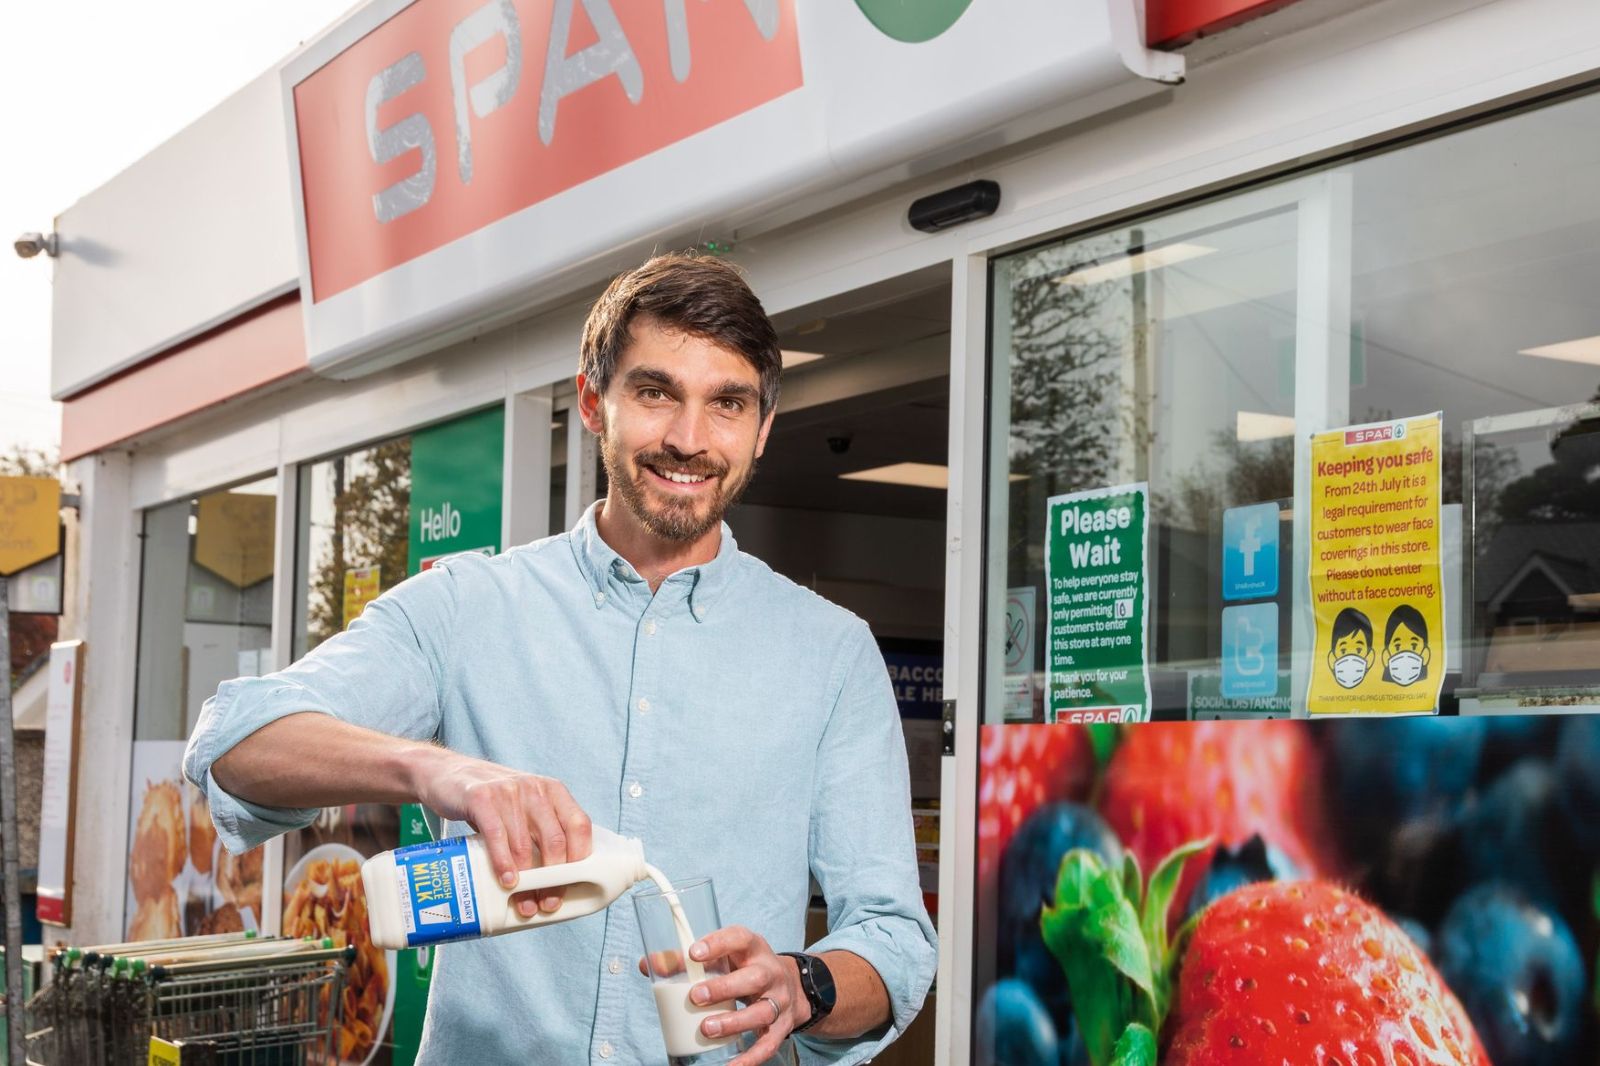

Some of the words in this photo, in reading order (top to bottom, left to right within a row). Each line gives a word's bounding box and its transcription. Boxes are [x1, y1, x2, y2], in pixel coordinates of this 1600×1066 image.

[1355, 428, 1392, 442] SPAR
[1318, 455, 1374, 478] Keeping
[1376, 454, 1403, 474] you
[1405, 446, 1433, 466] safe
[1325, 485, 1351, 498] From
[1353, 480, 1377, 495] 24th
[1380, 477, 1400, 493] July
[1403, 476, 1411, 488] it
[1412, 474, 1419, 487] is
[1420, 476, 1426, 486] a
[1323, 504, 1346, 521] legal
[1347, 498, 1412, 518] requirement
[1414, 495, 1428, 508] for
[421, 502, 461, 543] Hello
[1061, 506, 1130, 536] Please
[1318, 525, 1371, 540] customers
[1373, 523, 1384, 535] to
[1386, 522, 1411, 533] wear
[1413, 517, 1433, 530] face
[1069, 535, 1121, 568] Wait
[1321, 545, 1368, 561] coverings
[1370, 544, 1379, 556] in
[1381, 542, 1400, 555] this
[1401, 540, 1430, 553] store.
[1053, 578, 1062, 589] To
[1063, 576, 1080, 590] help
[1081, 574, 1119, 587] everyone
[1120, 570, 1138, 583] stay
[1327, 569, 1358, 581] Please
[1360, 566, 1374, 578] do
[1375, 565, 1393, 576] not
[1394, 563, 1422, 574] enter
[1054, 592, 1071, 605] safe,
[1072, 592, 1083, 602] we
[1085, 591, 1097, 601] are
[1099, 584, 1138, 599] currently
[1318, 589, 1356, 603] without
[1357, 590, 1364, 599] a
[1365, 586, 1388, 599] face
[1389, 581, 1435, 599] covering.
[1054, 607, 1070, 621] only
[1070, 603, 1112, 621] permitting
[1054, 622, 1095, 635] customers
[1095, 621, 1104, 631] to
[1105, 619, 1127, 630] enter
[1054, 638, 1068, 650] this
[1070, 638, 1090, 649] store
[1091, 637, 1100, 648] at
[1100, 637, 1115, 648] any
[1116, 635, 1131, 646] one
[1054, 653, 1075, 666] time.
[888, 665, 943, 682] BACCO
[1054, 671, 1080, 684] Thank
[1081, 671, 1096, 685] you
[1096, 669, 1108, 681] for
[1109, 670, 1128, 683] your
[1054, 686, 1093, 702] patience.
[1194, 696, 1230, 708] SOCIAL
[412, 863, 434, 903] MILK
[430, 861, 444, 900] WHOLE
[439, 860, 452, 899] CORNISH
[464, 900, 472, 919] DAIRY
